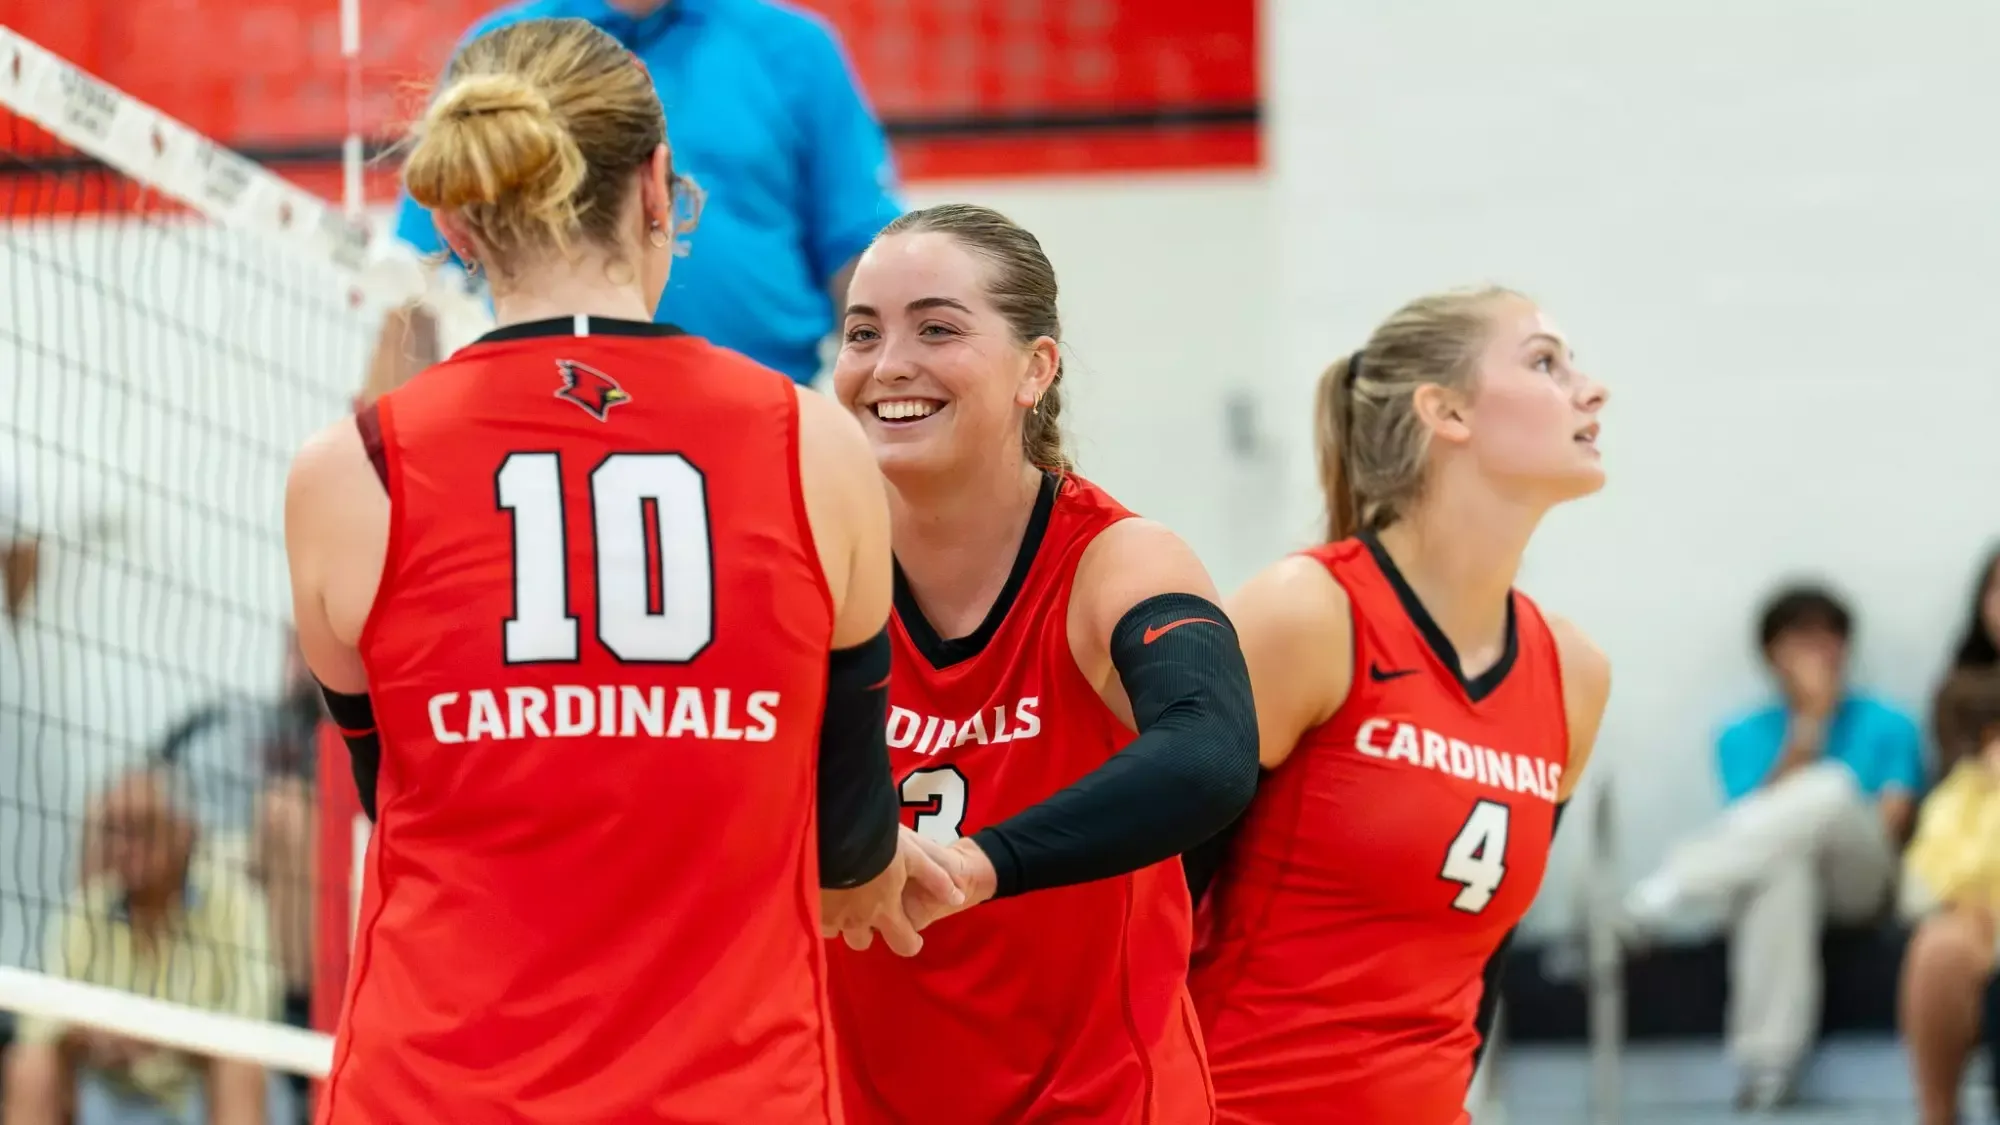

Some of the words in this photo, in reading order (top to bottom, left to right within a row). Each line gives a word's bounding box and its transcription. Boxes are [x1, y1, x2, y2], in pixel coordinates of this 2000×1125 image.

[494, 450, 714, 666] 10
[428, 685, 780, 744] CARDINALS
[885, 696, 1041, 755] DINALS
[1355, 717, 1562, 803] CARDINALS
[899, 764, 969, 847] 3
[1437, 796, 1510, 915] 4
